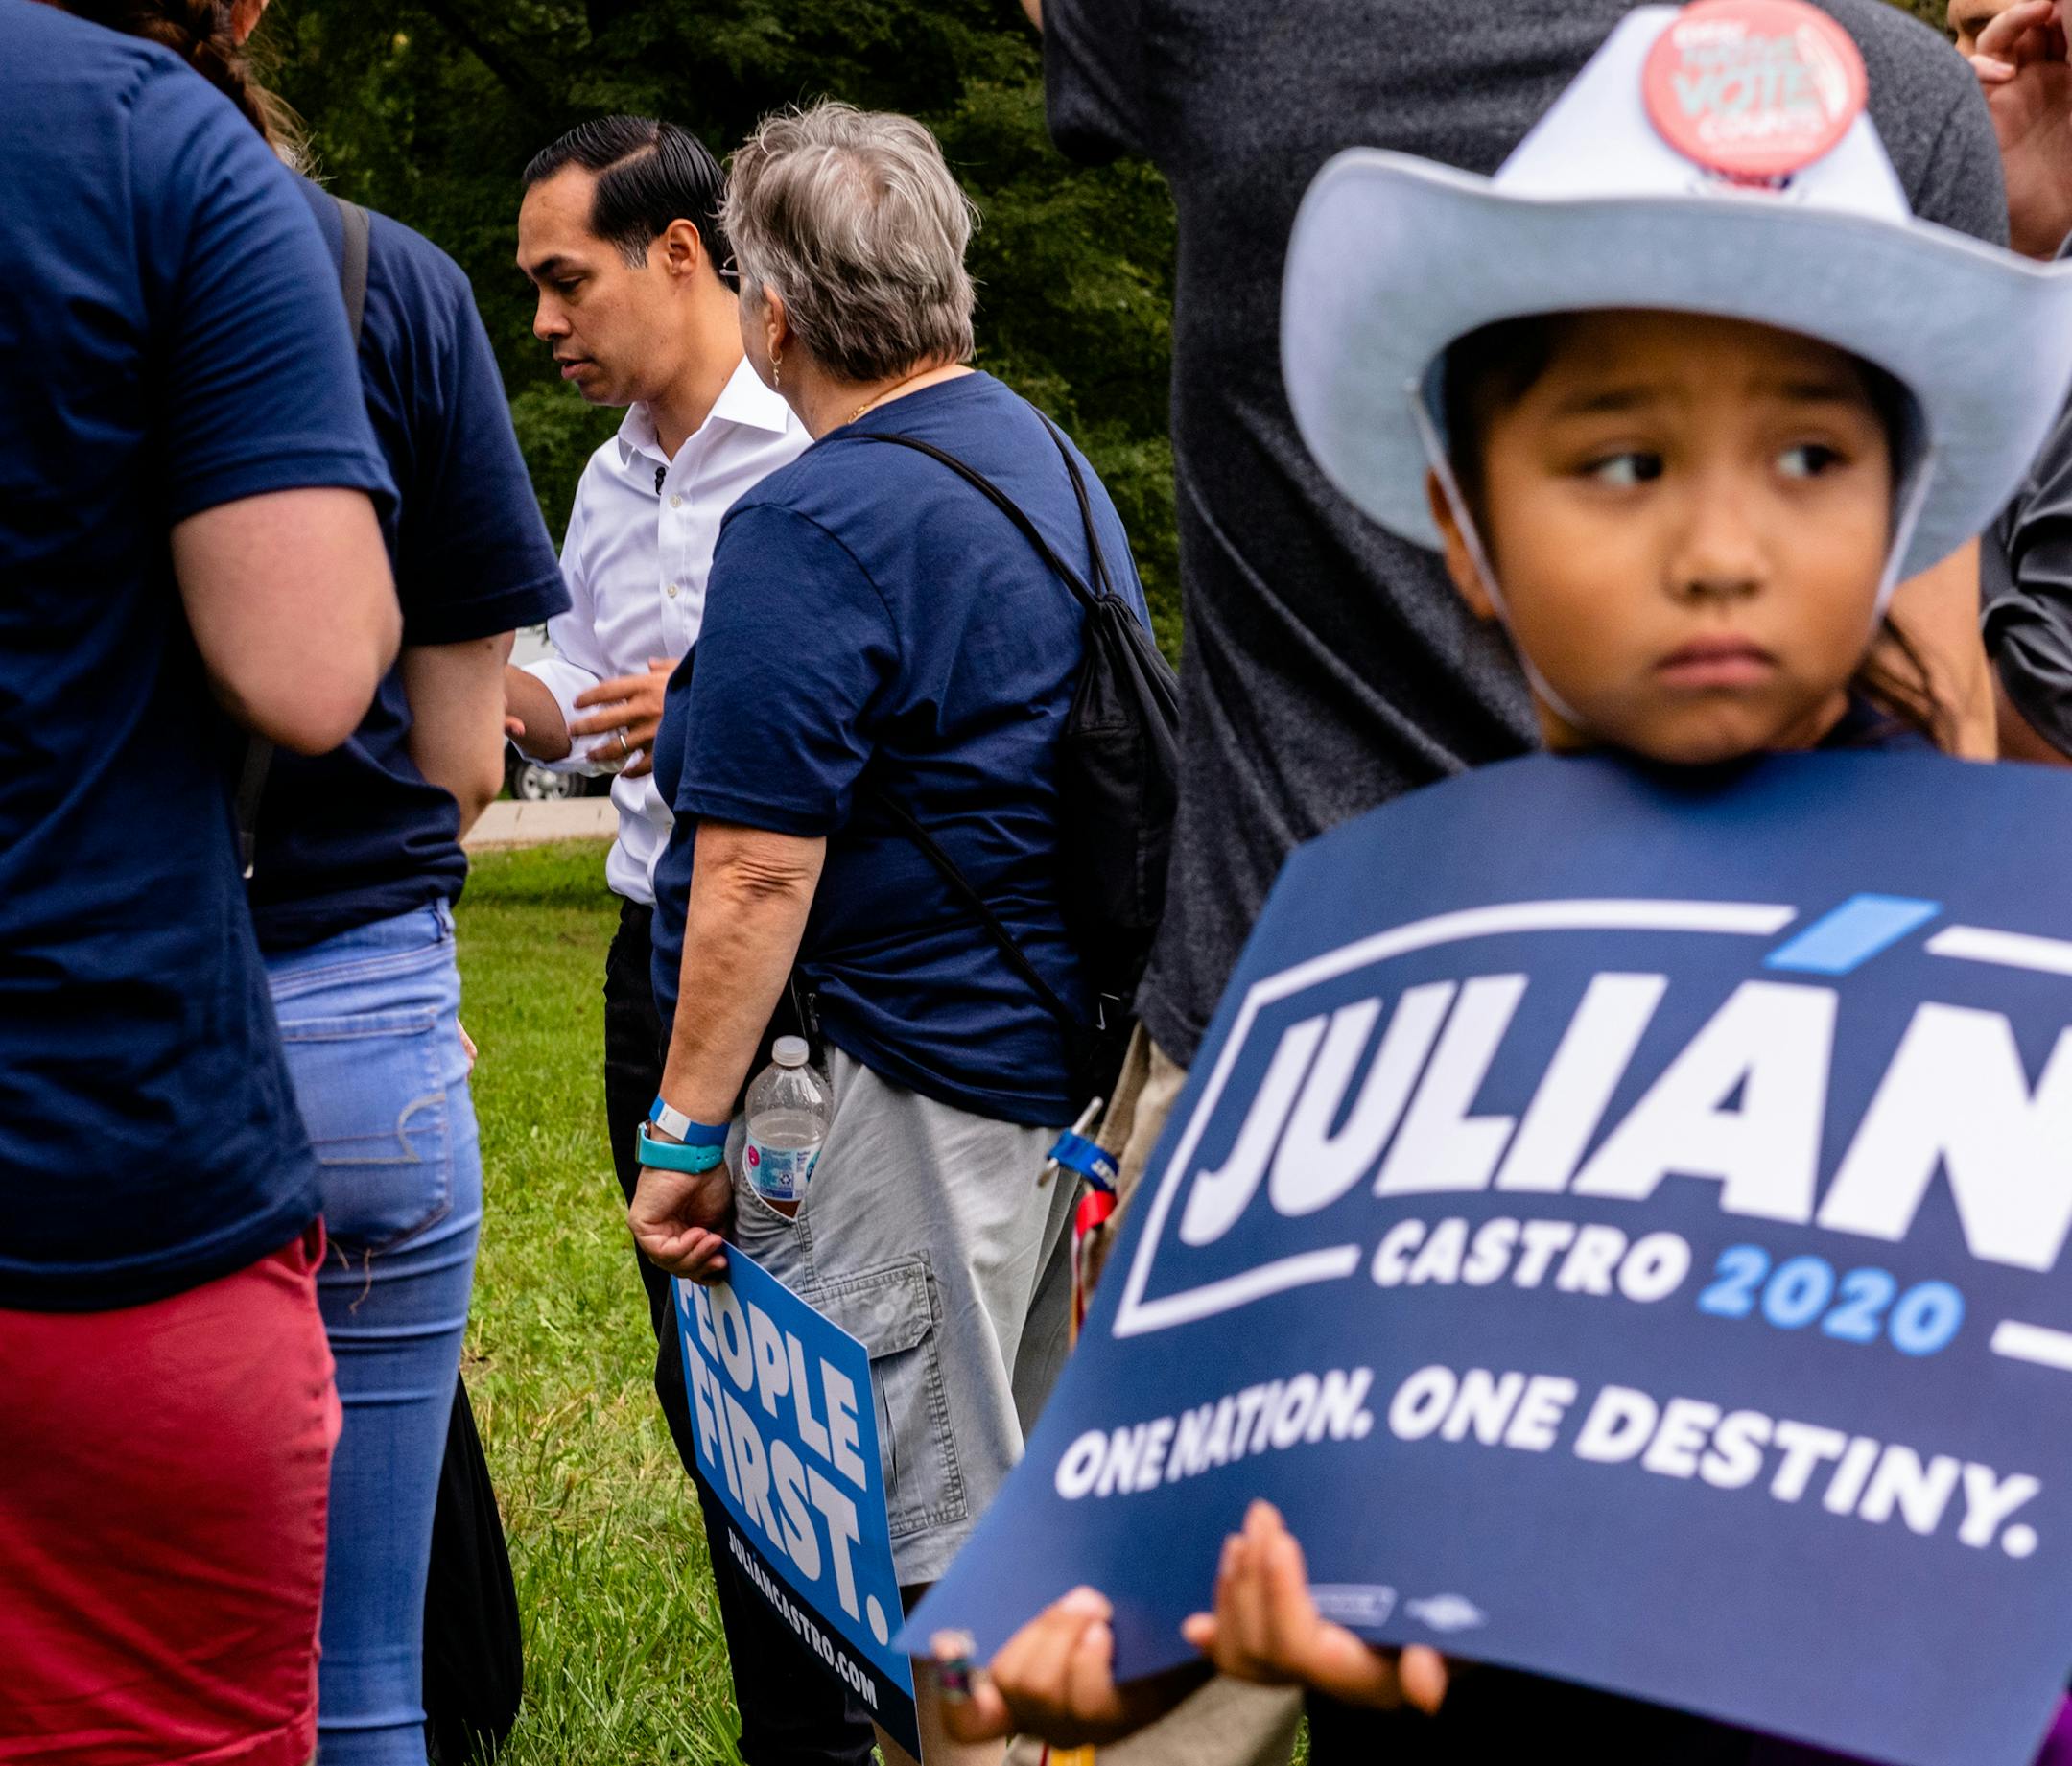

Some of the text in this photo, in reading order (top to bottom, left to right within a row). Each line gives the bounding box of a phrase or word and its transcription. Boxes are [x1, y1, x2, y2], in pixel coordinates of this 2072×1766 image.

[1672, 62, 1824, 117] VOTE
[1372, 1216, 1966, 1356] CASTRO 2020
[685, 1331, 889, 1646] FIRST.
[1055, 1364, 2041, 1559] ONE NATION. ONE DESTINY.
